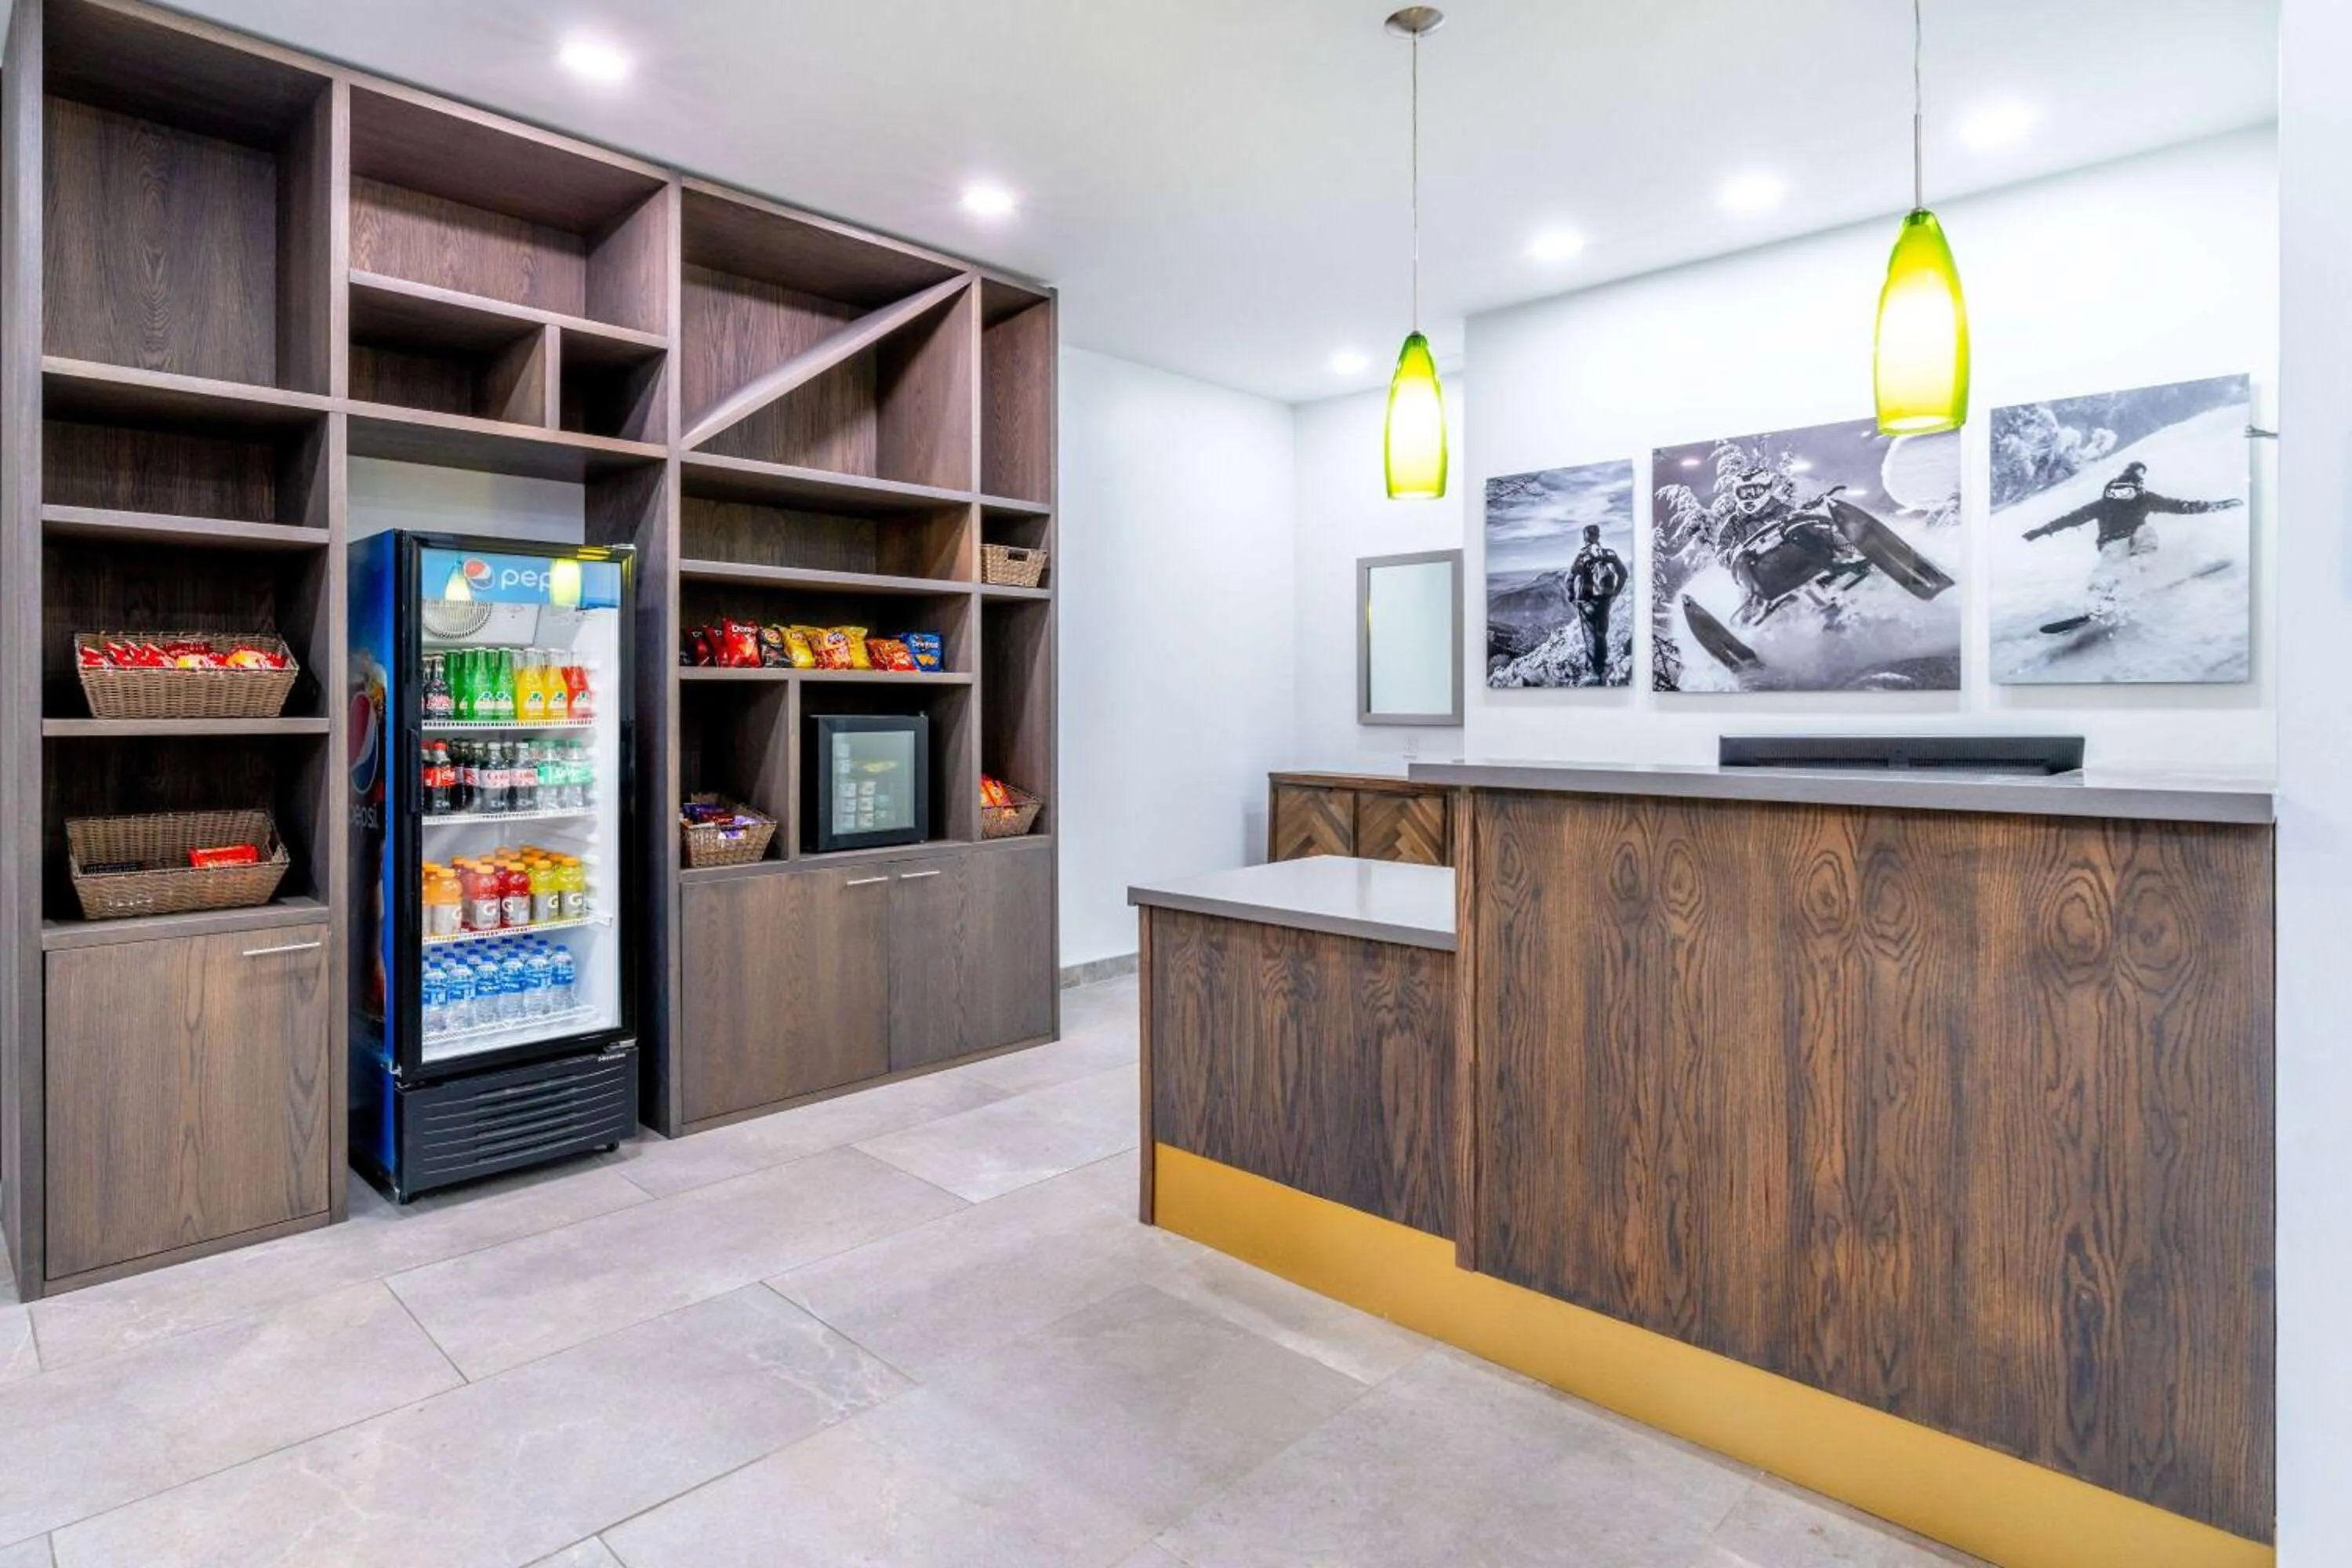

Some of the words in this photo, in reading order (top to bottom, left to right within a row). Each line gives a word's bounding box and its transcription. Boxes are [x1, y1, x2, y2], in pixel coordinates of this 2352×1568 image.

[501, 568, 552, 592] pep
[501, 898, 514, 912] G
[549, 896, 559, 909] G
[568, 893, 583, 906] G
[483, 902, 496, 916] G
